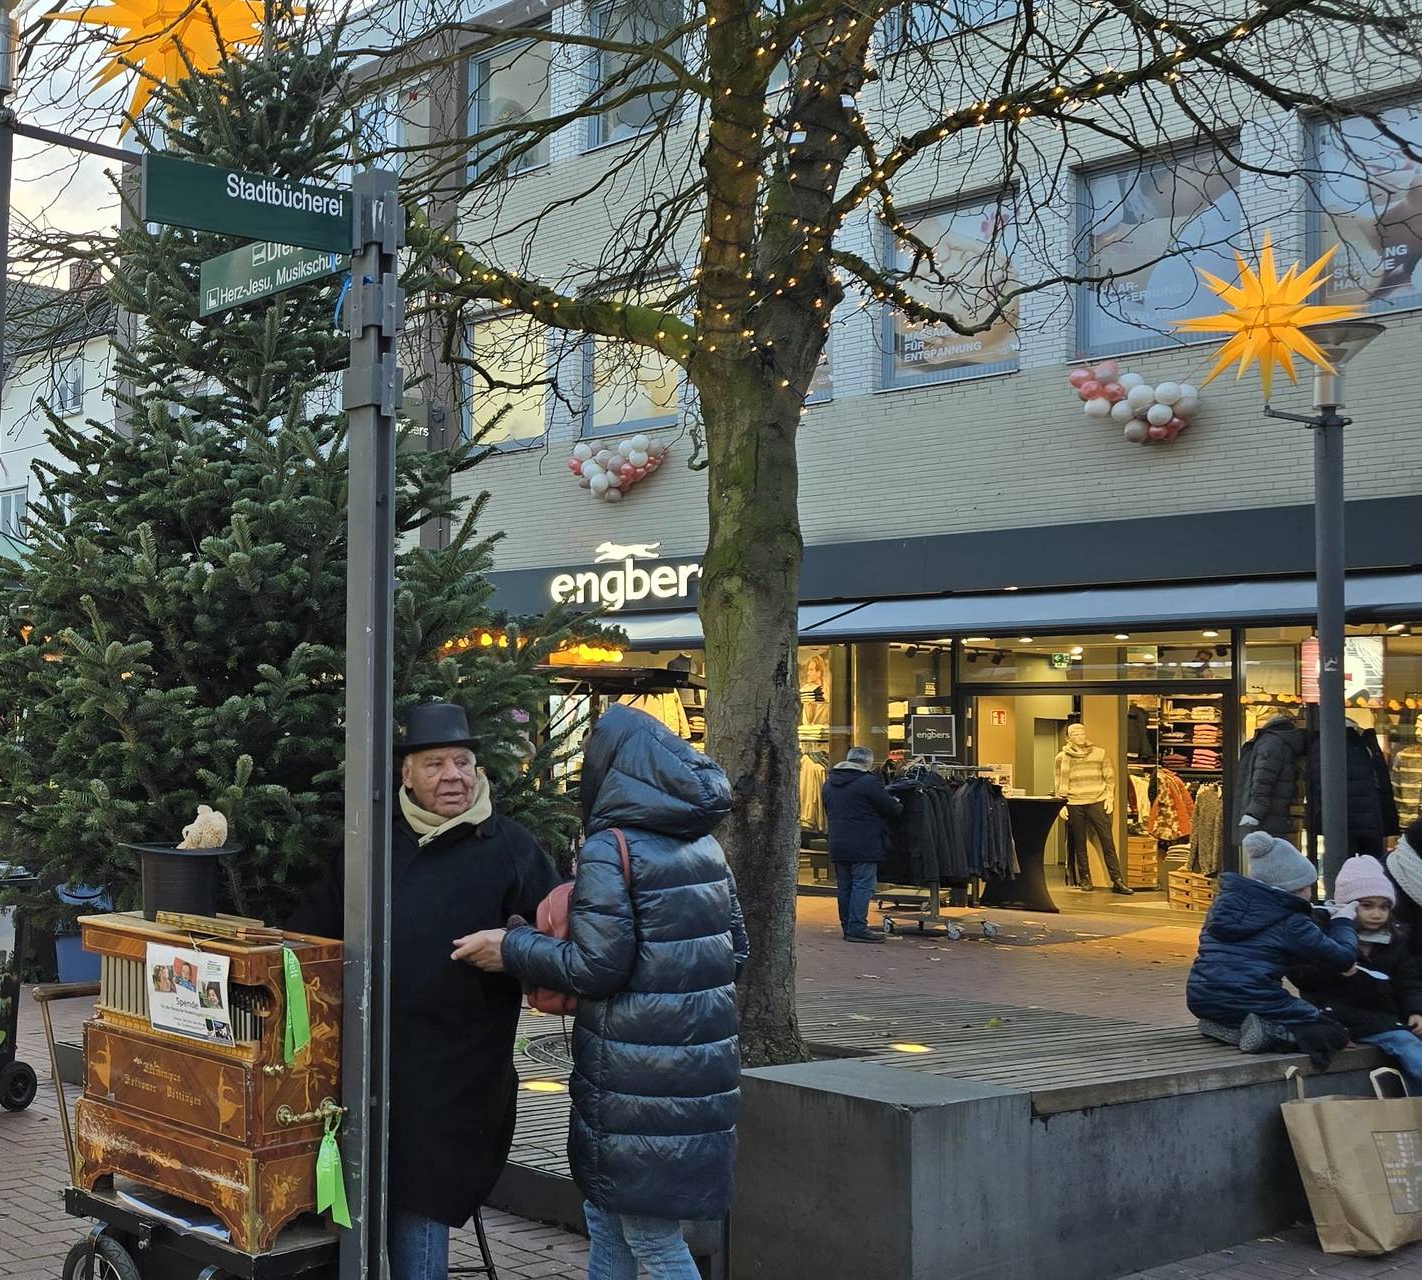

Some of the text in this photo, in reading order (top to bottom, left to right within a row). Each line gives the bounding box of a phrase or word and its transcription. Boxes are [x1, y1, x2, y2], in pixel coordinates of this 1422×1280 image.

[227, 173, 343, 217] Stadtbücherei
[220, 253, 343, 305] Herz-Jesu, Musikschue
[904, 340, 925, 352] FÜR
[904, 342, 982, 363] ENTSPANNUNG
[550, 558, 704, 612] engber
[916, 731, 951, 740] engbers
